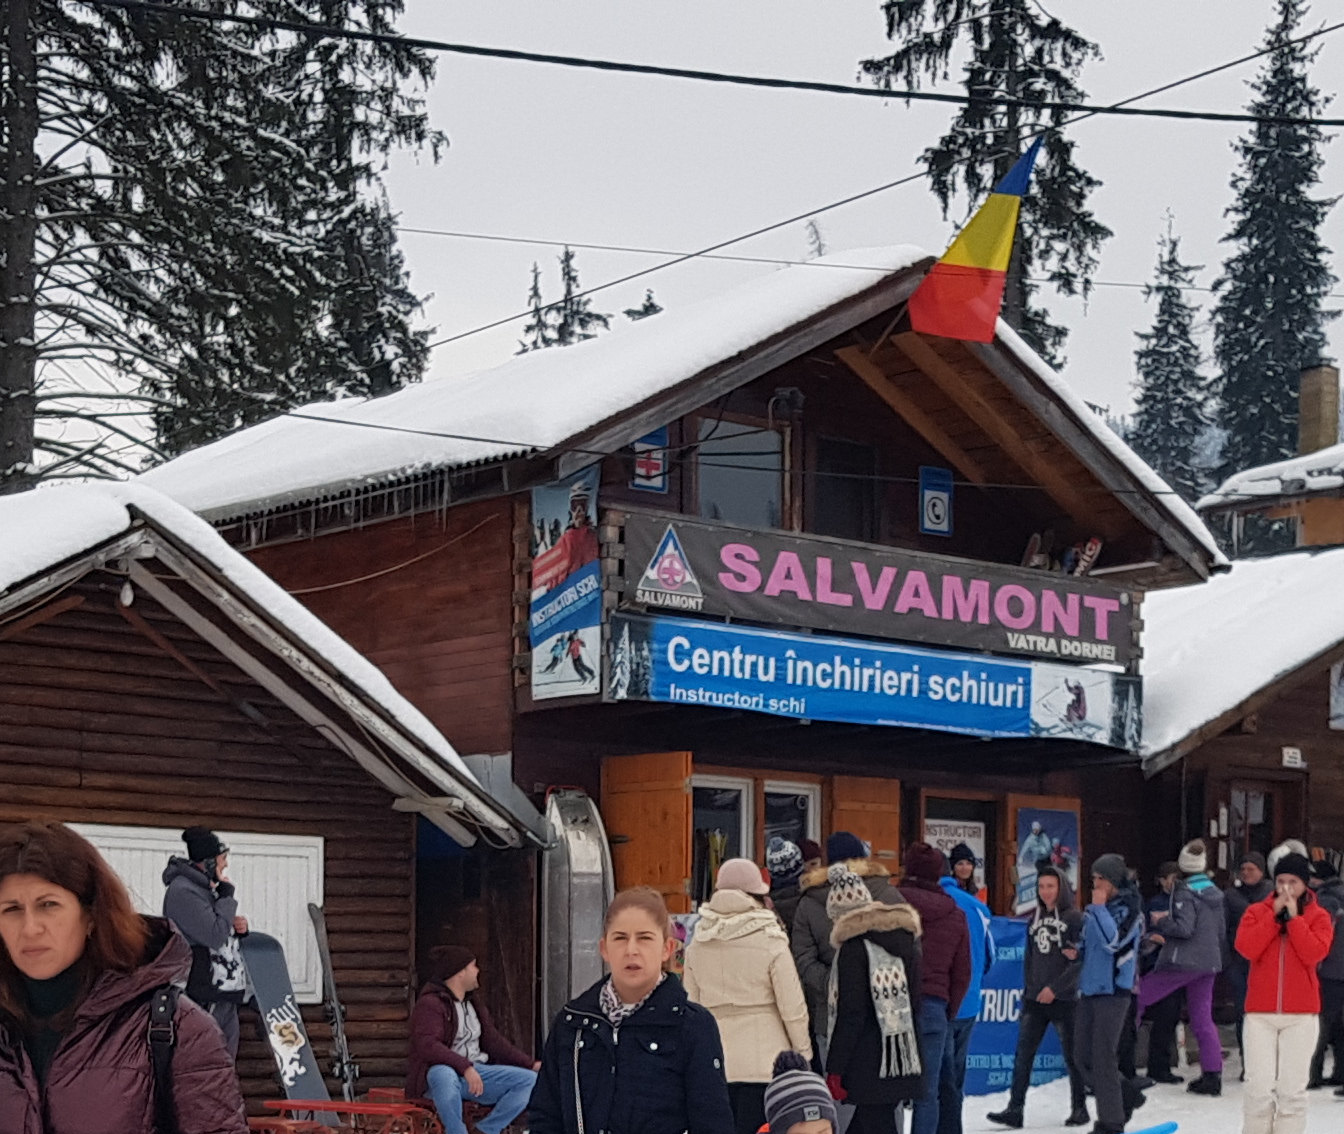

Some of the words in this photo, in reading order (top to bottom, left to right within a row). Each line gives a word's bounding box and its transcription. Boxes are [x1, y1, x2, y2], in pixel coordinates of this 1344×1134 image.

[635, 589, 704, 611] SALVAMONT
[718, 542, 1120, 641] SALVAMONT
[1006, 632, 1059, 653] VATRA
[1061, 639, 1117, 661] DORNEI
[667, 635, 776, 683] Centru
[785, 649, 920, 698] închirieri
[928, 670, 1025, 709] schiuri
[669, 683, 764, 709] Instructori
[769, 696, 806, 714] schi
[926, 824, 982, 839] NSTRUCTORI
[976, 989, 1024, 1022] TRUC
